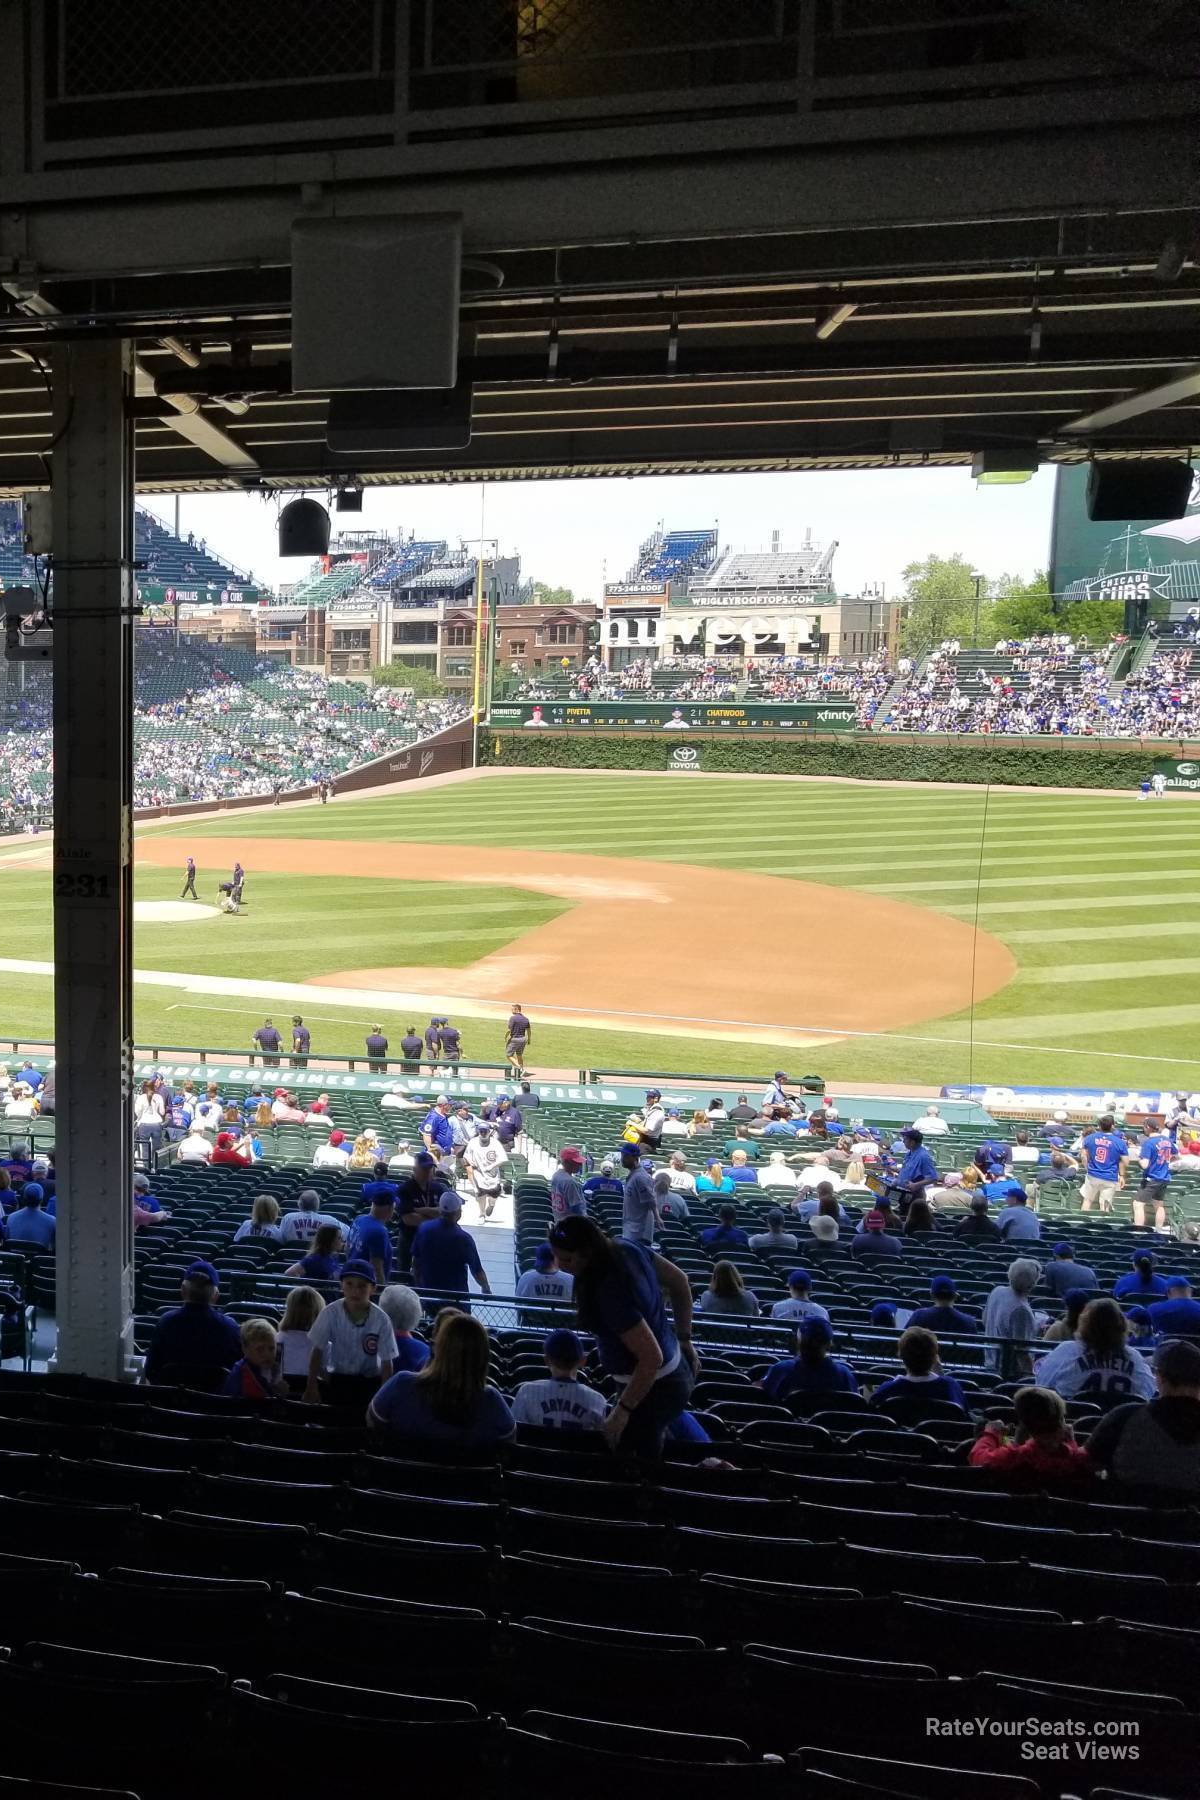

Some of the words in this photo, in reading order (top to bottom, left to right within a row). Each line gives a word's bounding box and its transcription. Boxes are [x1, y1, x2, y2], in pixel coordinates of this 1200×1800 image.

[1100, 573, 1149, 588] CHICAGO
[175, 590, 198, 600] PHILLIES
[230, 592, 243, 601] CUBS
[692, 594, 815, 606] WRIGLEYROOFTOPS.COM
[596, 614, 814, 646] nuveen
[706, 709, 745, 717] CHATWOOD
[816, 709, 854, 723] xfinity
[56, 874, 112, 898] 231
[228, 1069, 357, 1087] CONFINES
[539, 1086, 618, 1101] FIELD
[1095, 1148, 1108, 1163] 9
[534, 1284, 564, 1297] RIZZO
